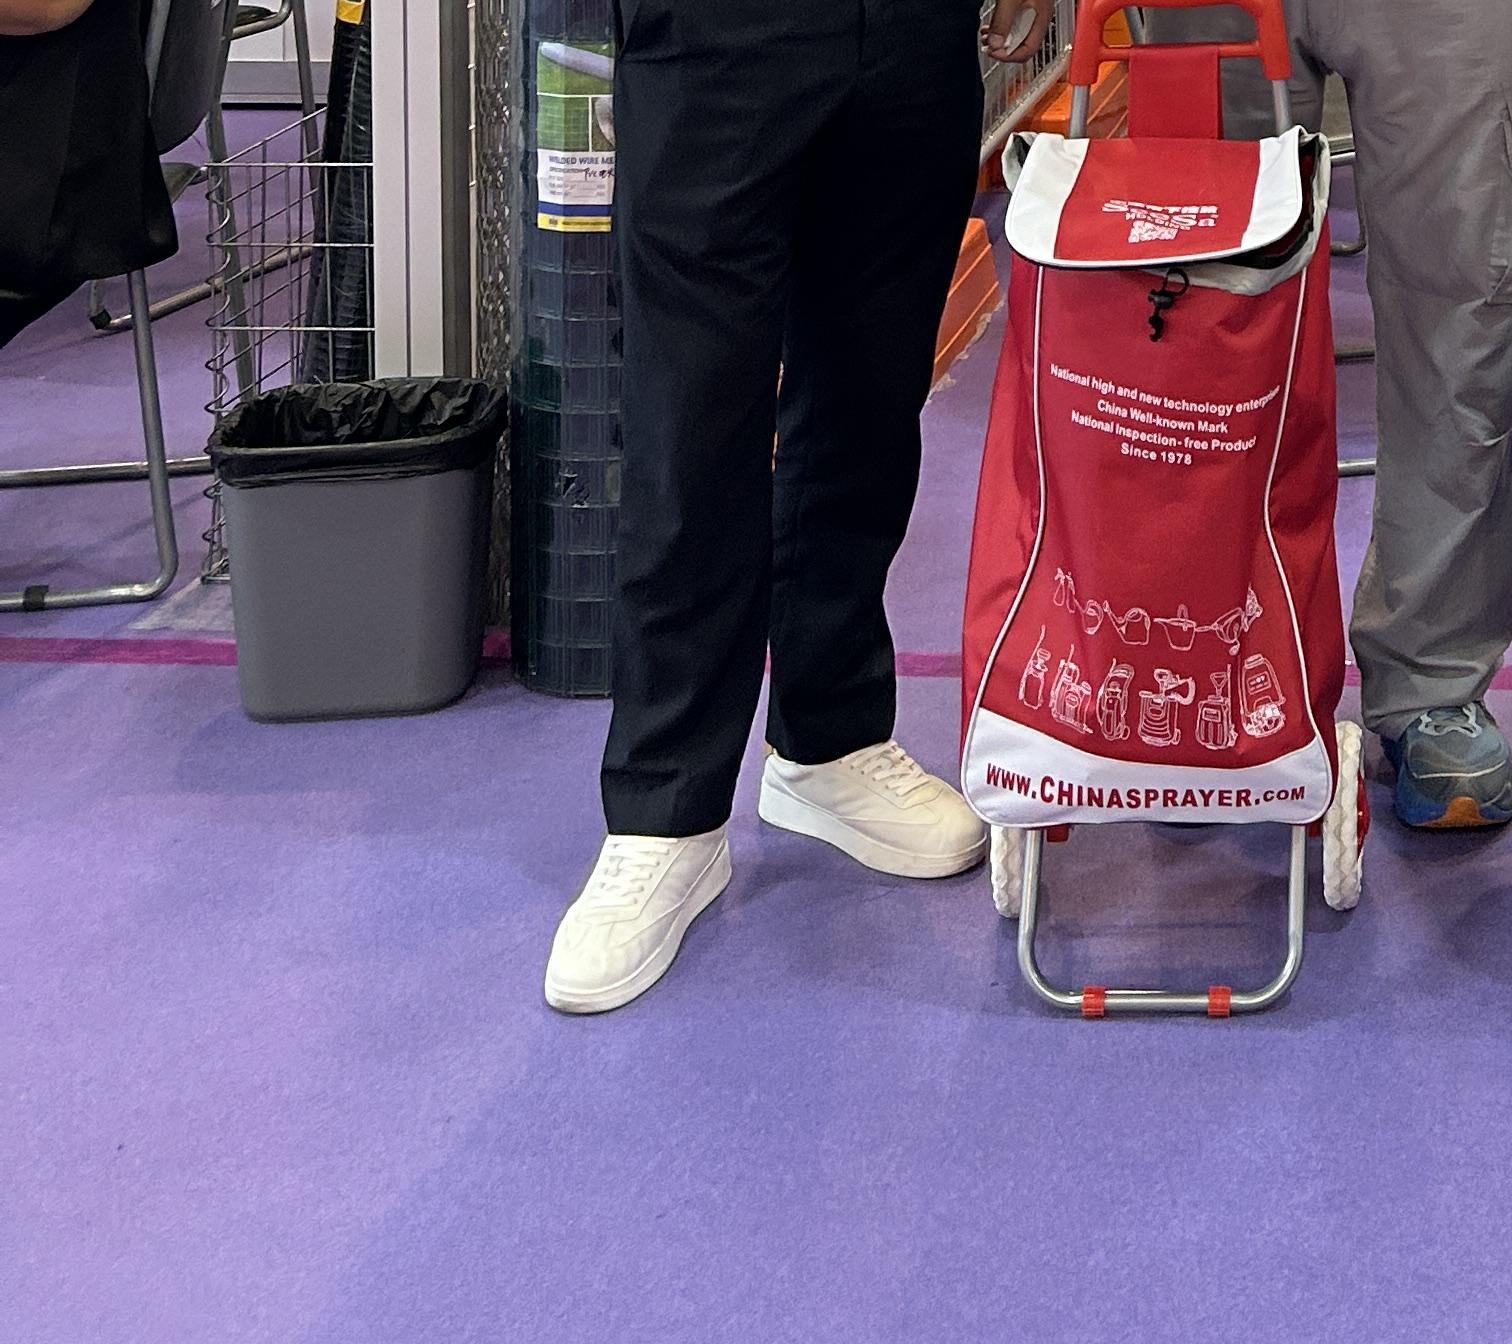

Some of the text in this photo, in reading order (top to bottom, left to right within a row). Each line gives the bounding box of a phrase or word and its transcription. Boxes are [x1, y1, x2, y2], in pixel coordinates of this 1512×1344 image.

[1051, 363, 1090, 388] National
[1091, 376, 1116, 395] high
[1116, 385, 1138, 400] and
[1139, 392, 1162, 407] new
[1163, 396, 1233, 417] technology
[1071, 410, 1114, 434] National
[1097, 400, 1128, 419] China
[1198, 417, 1229, 434] Mark
[1121, 443, 1192, 465] Since 1978
